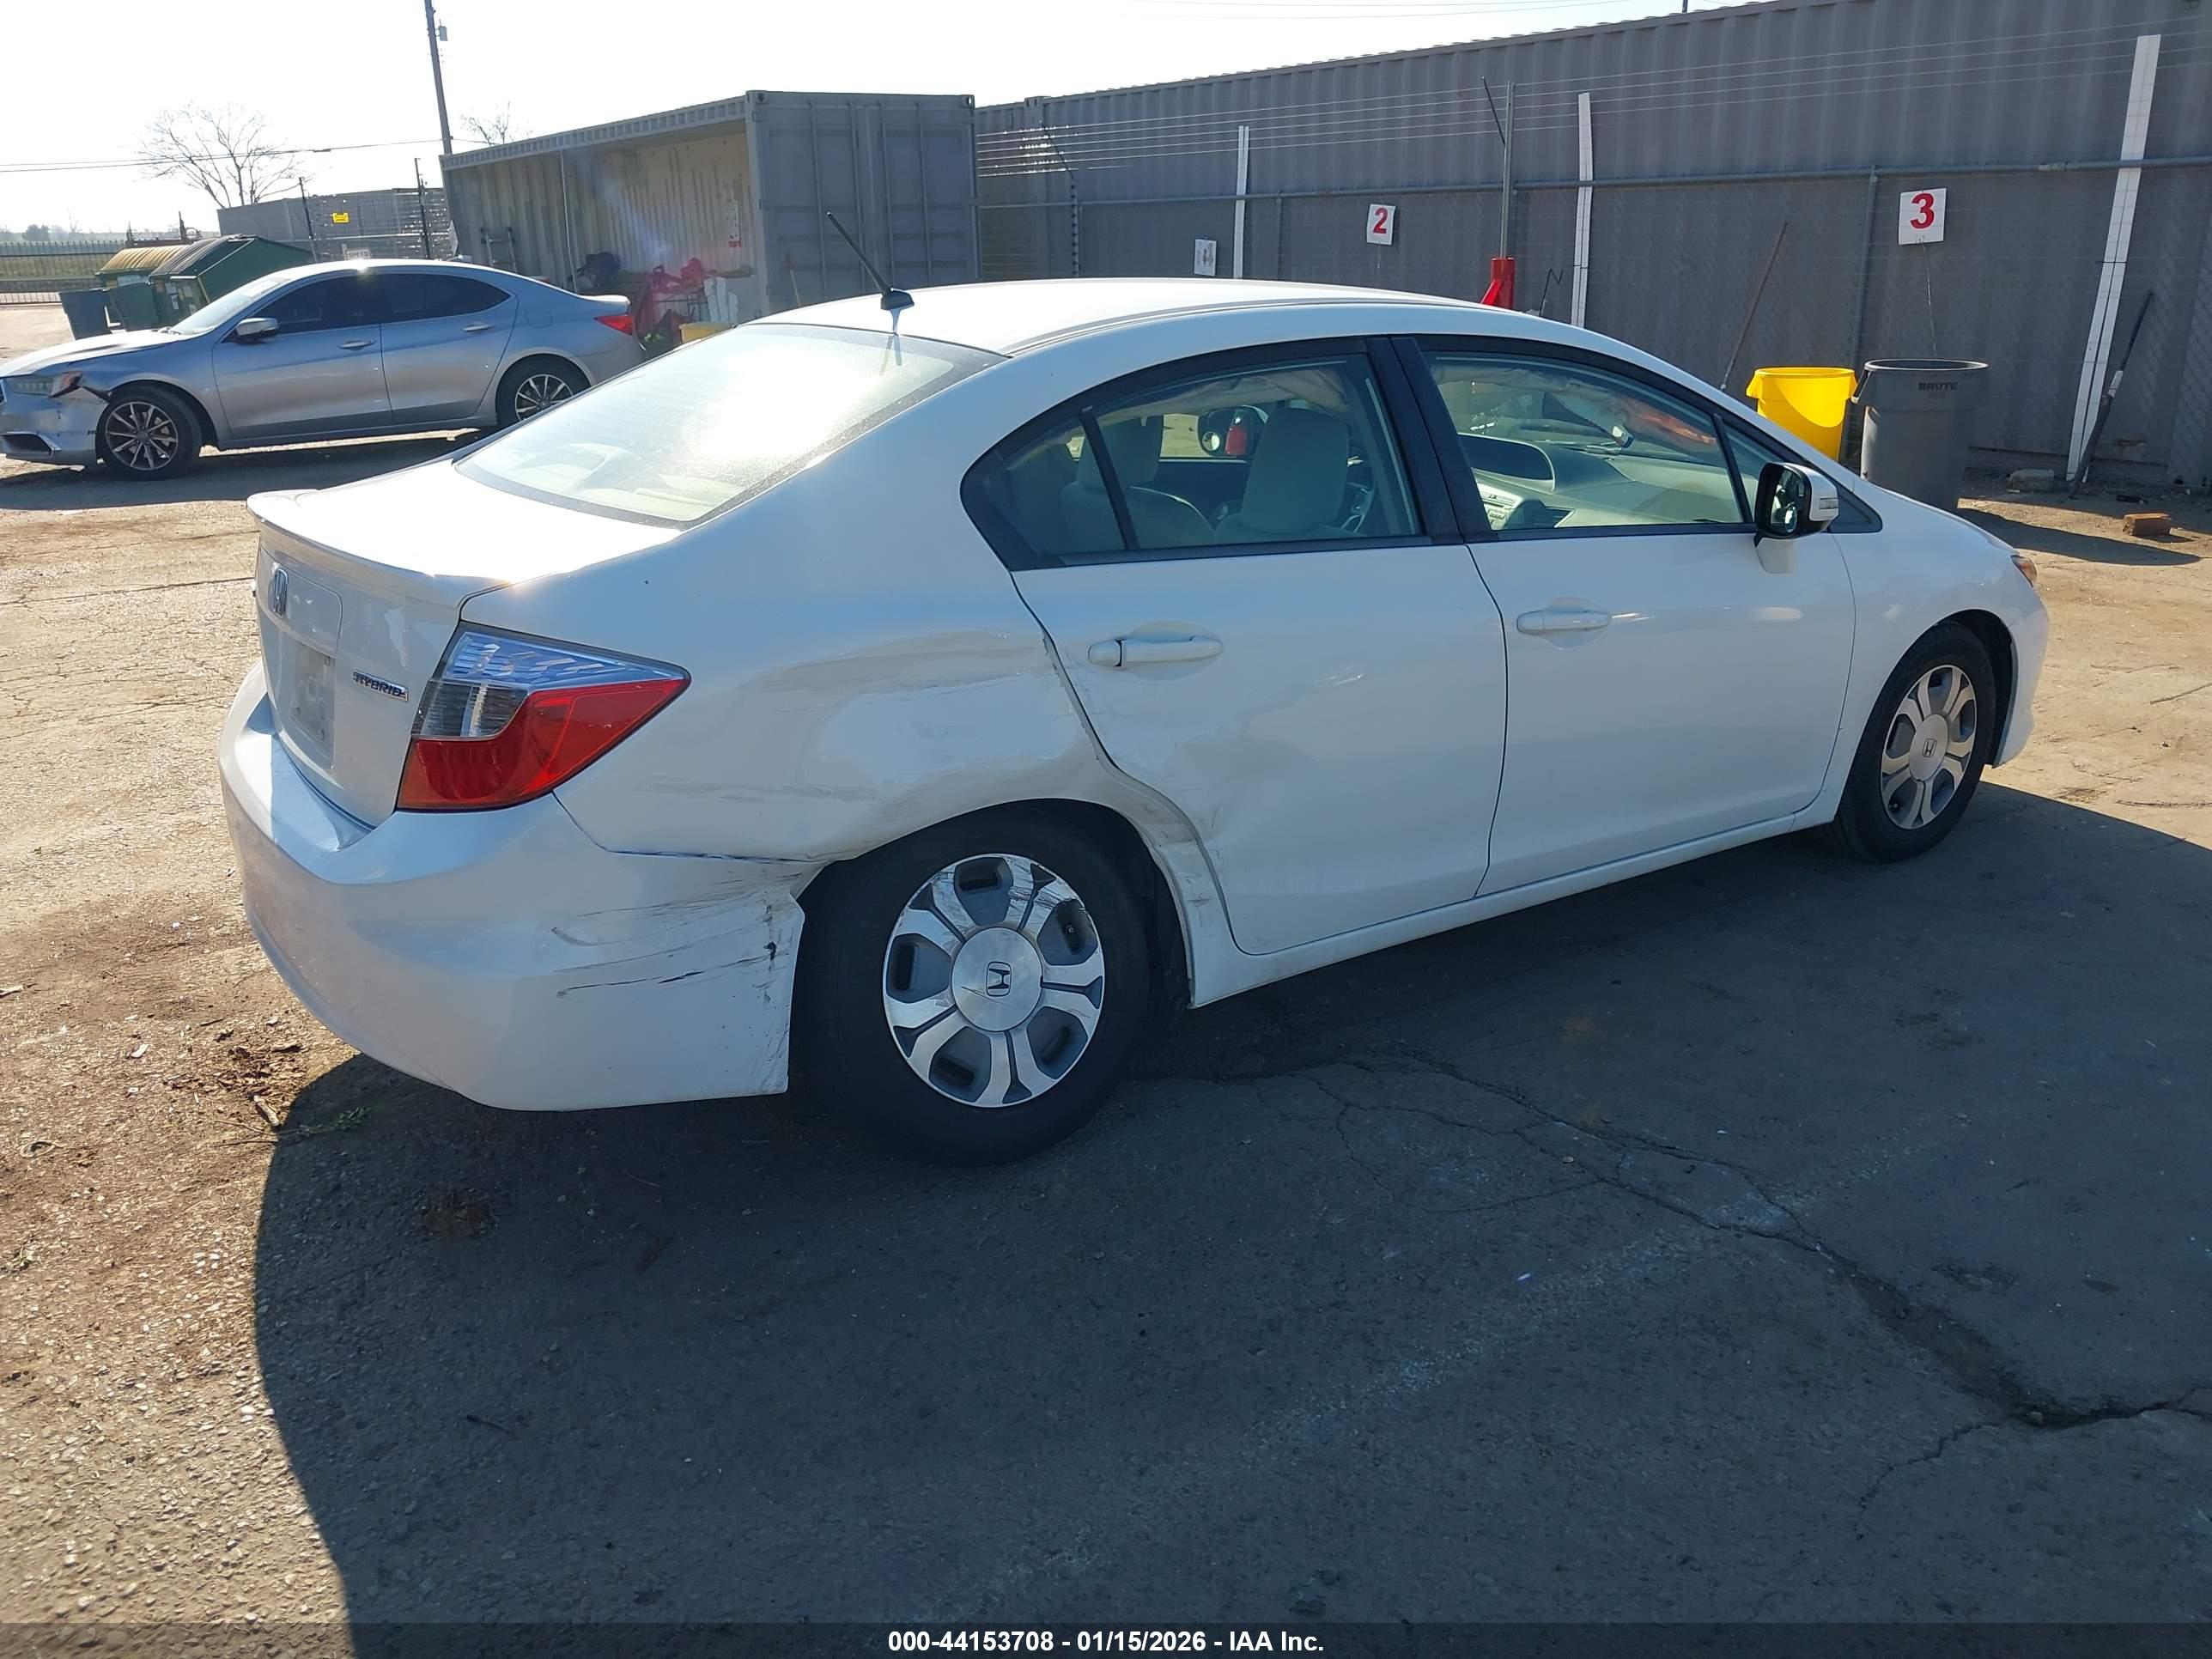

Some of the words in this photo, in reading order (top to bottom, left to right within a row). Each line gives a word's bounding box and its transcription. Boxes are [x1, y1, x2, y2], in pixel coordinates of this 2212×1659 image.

[1373, 207, 1388, 234] 2
[1910, 192, 1935, 229] 3
[1917, 381, 1958, 391] BRUTE
[352, 671, 406, 697] HYBRID
